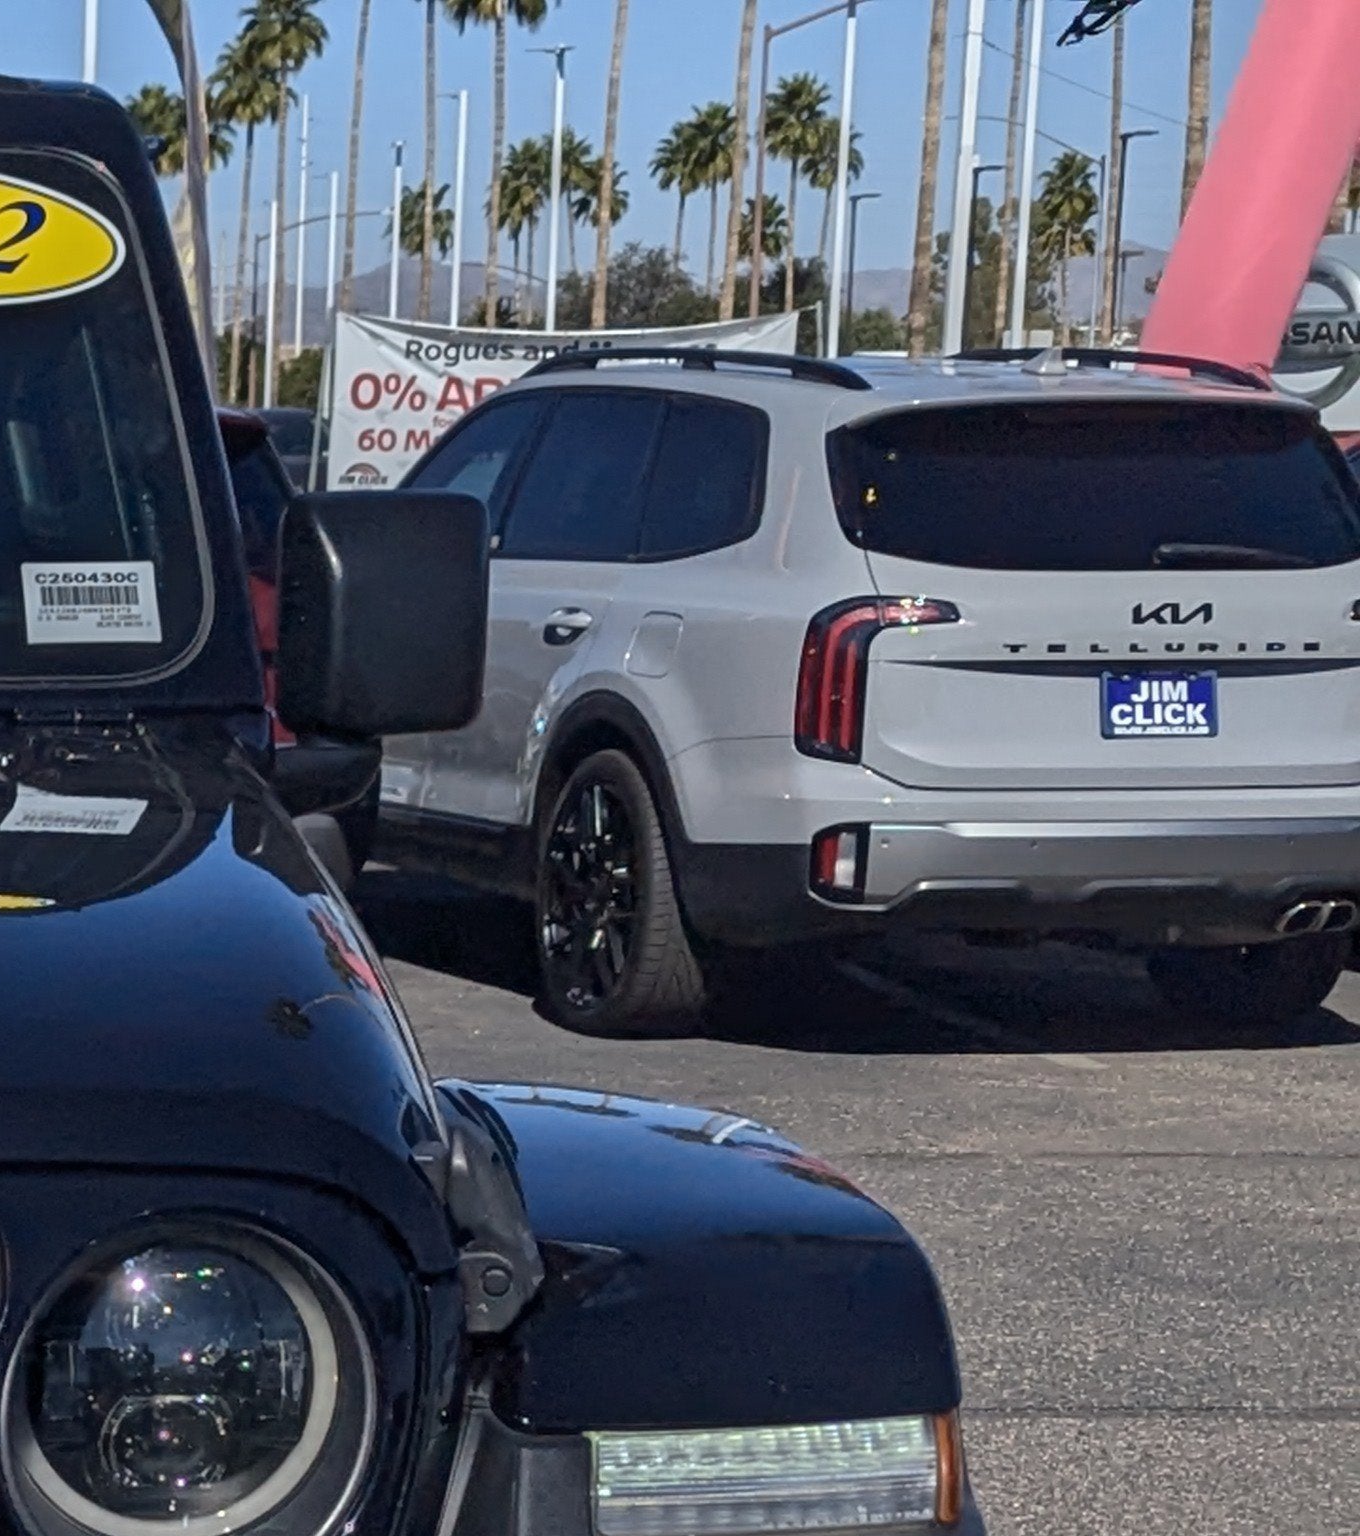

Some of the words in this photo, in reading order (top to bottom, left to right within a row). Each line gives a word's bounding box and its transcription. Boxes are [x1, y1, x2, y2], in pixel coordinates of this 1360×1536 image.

[405, 339, 514, 366] Rogues
[350, 372, 427, 412] 0%
[435, 375, 518, 413] AP
[357, 428, 397, 452] 60
[34, 572, 139, 584] C250430C
[1131, 602, 1213, 625] KIA
[1003, 642, 1320, 653] TELLURIDE
[1130, 680, 1189, 702] JIM
[1110, 703, 1208, 725] CLICK
